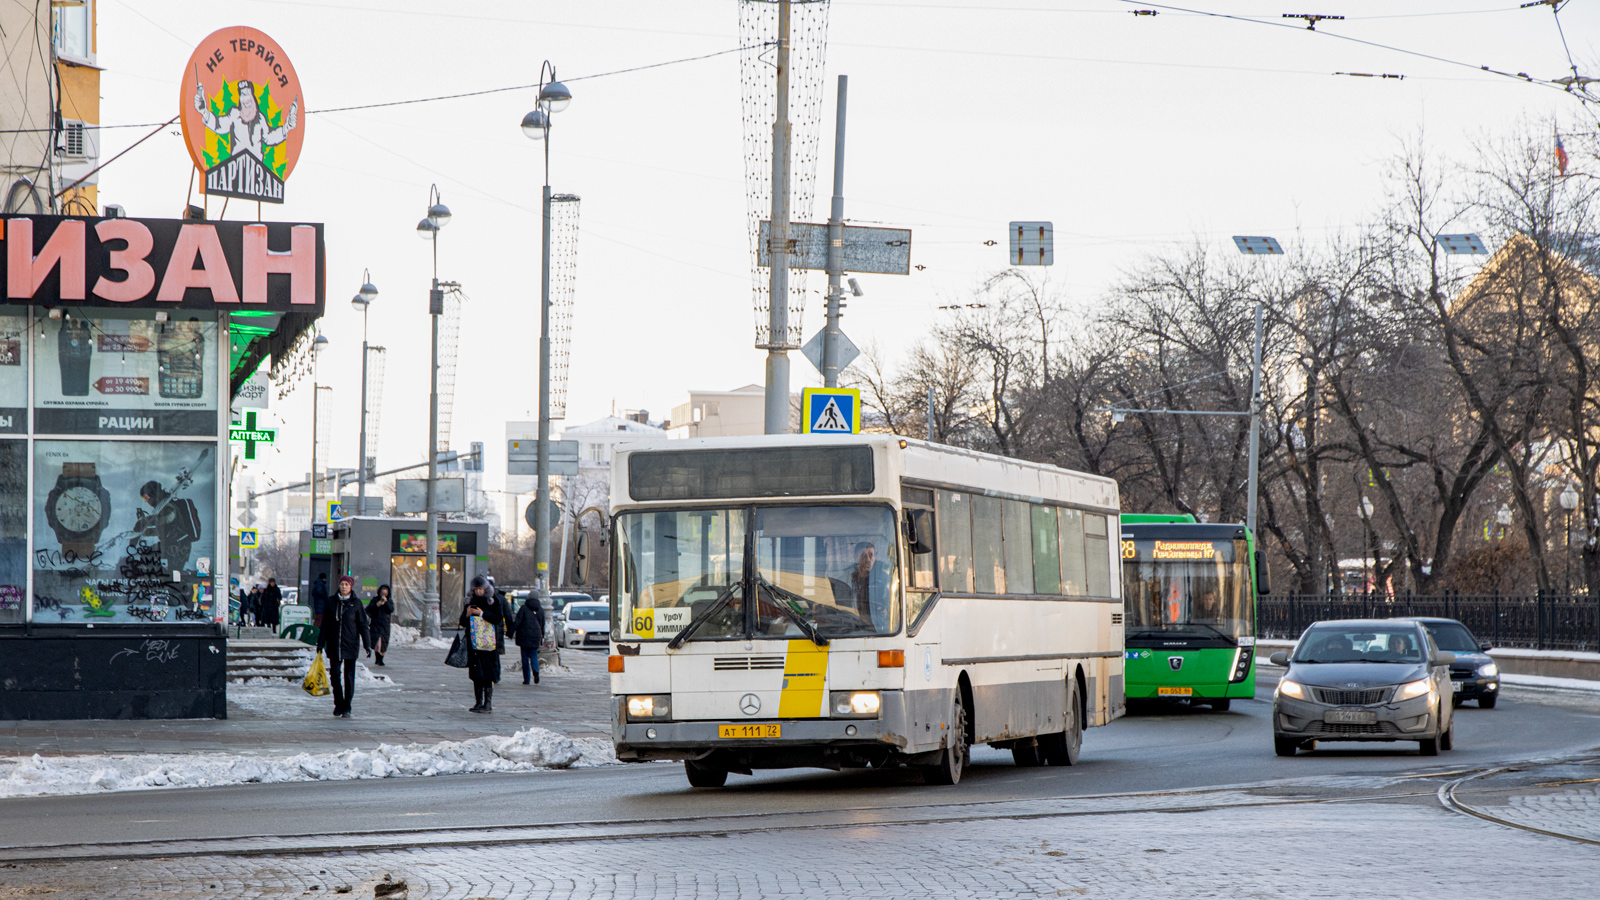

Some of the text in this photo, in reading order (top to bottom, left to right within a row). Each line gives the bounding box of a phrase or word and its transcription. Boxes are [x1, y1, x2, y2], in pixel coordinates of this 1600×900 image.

[206, 39, 289, 88] НЕ ТЕРЯЙСЯ
[207, 153, 283, 199] ПАРТИЗАН
[0, 217, 316, 304] ИЗАН
[98, 416, 154, 430] РАЦИИ
[231, 431, 270, 441] АПТЕКА
[635, 616, 653, 631] 60
[663, 613, 683, 622] УрФУ
[742, 726, 761, 737] 111
[766, 725, 777, 733] 72
